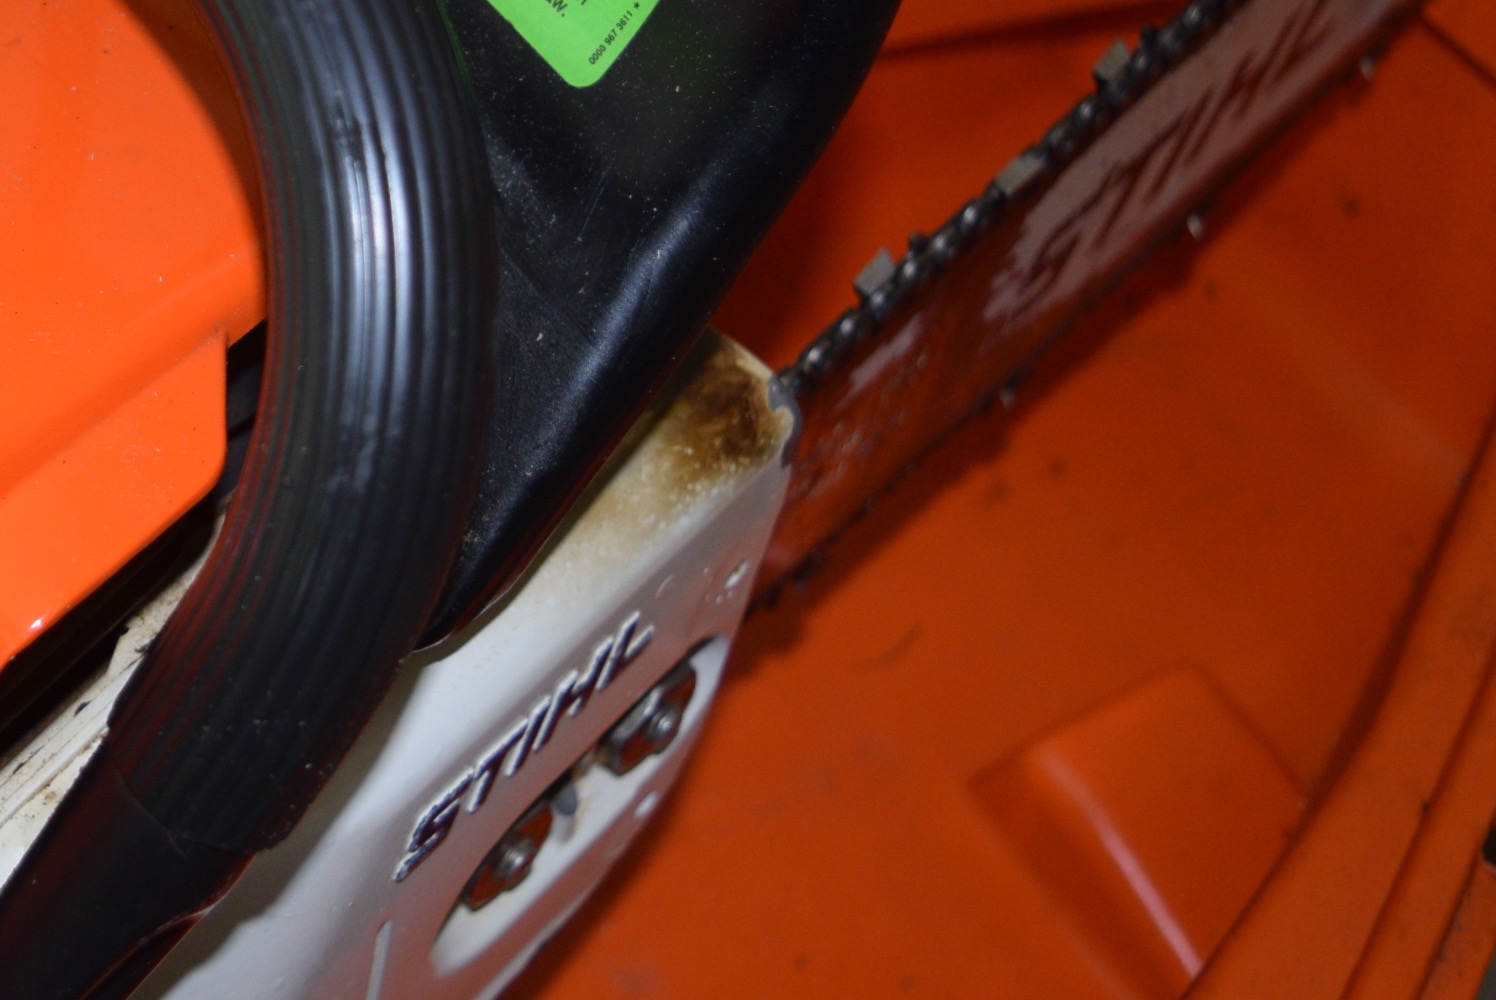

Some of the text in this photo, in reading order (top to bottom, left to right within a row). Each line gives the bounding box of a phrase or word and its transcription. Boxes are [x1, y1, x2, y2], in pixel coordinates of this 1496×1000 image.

[588, 10, 633, 65] 0000 967 3611
[392, 609, 655, 884] STIHL
